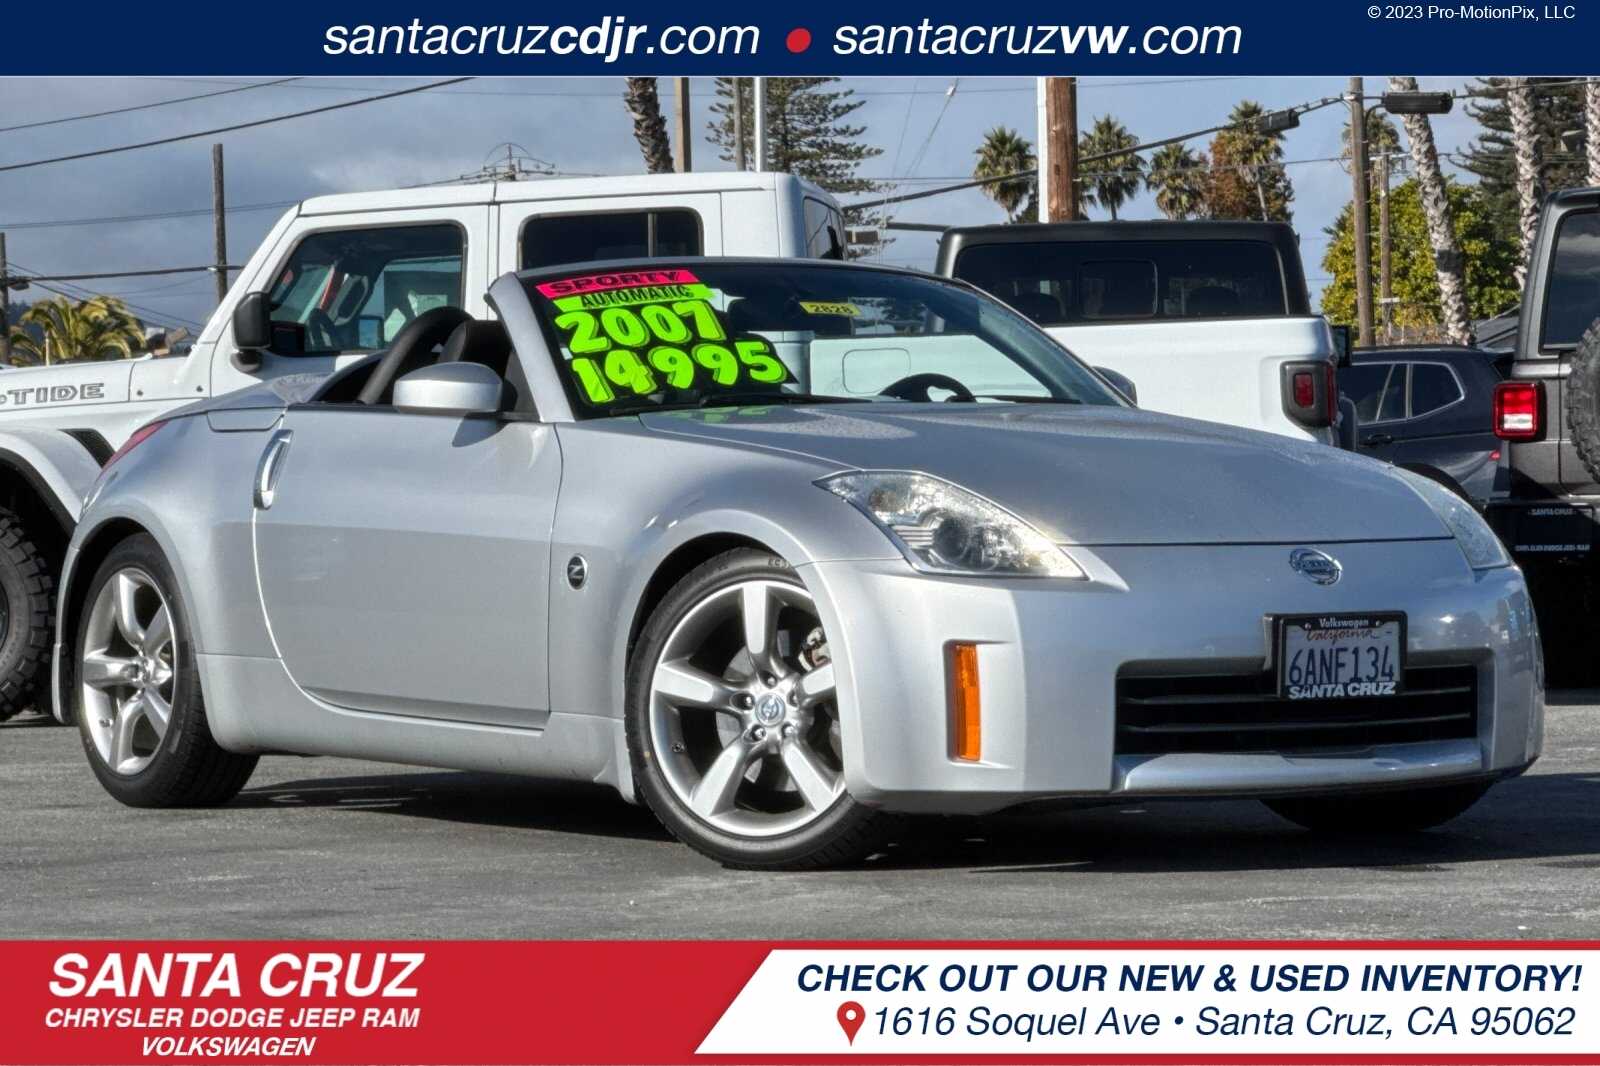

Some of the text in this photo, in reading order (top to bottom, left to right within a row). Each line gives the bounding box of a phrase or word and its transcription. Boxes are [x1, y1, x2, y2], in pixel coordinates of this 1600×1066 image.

[550, 272, 678, 292] SPORTY
[580, 284, 693, 308] AUTOMATIC
[554, 299, 726, 354] 2007
[571, 341, 788, 403] 14995
[7, 382, 104, 405] TIDE
[1319, 617, 1369, 629] Volkswagen
[1288, 645, 1394, 686] 6ANF134
[1289, 682, 1396, 699] SANTA CRUZ
